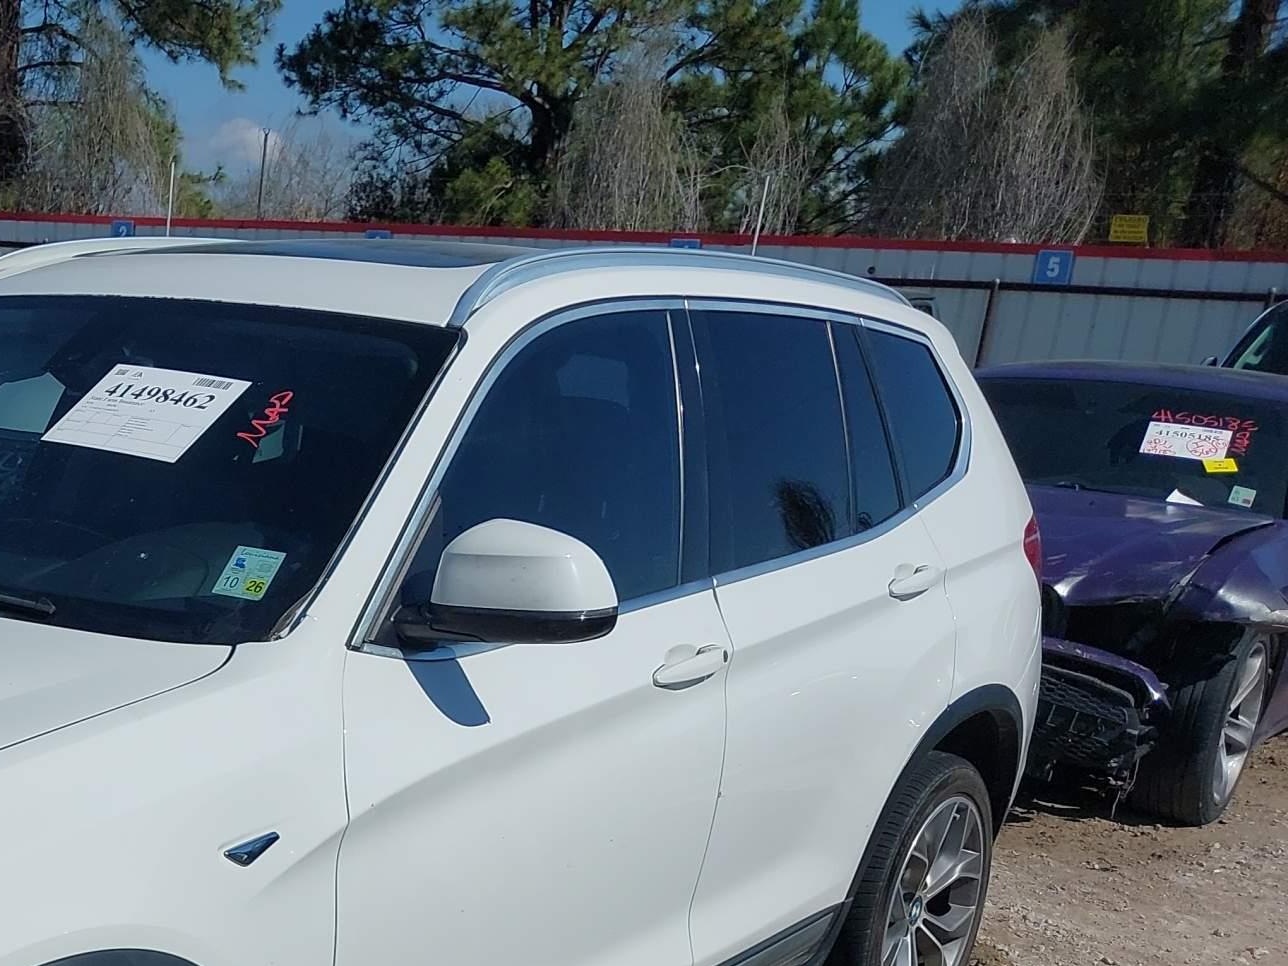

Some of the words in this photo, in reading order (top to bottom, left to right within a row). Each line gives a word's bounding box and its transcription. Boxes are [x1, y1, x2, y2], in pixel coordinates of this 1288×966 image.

[1046, 255, 1061, 278] 5
[104, 382, 216, 410] 41498462
[1152, 409, 1259, 431] 41505185
[223, 576, 239, 588] 10
[246, 581, 265, 593] 26
